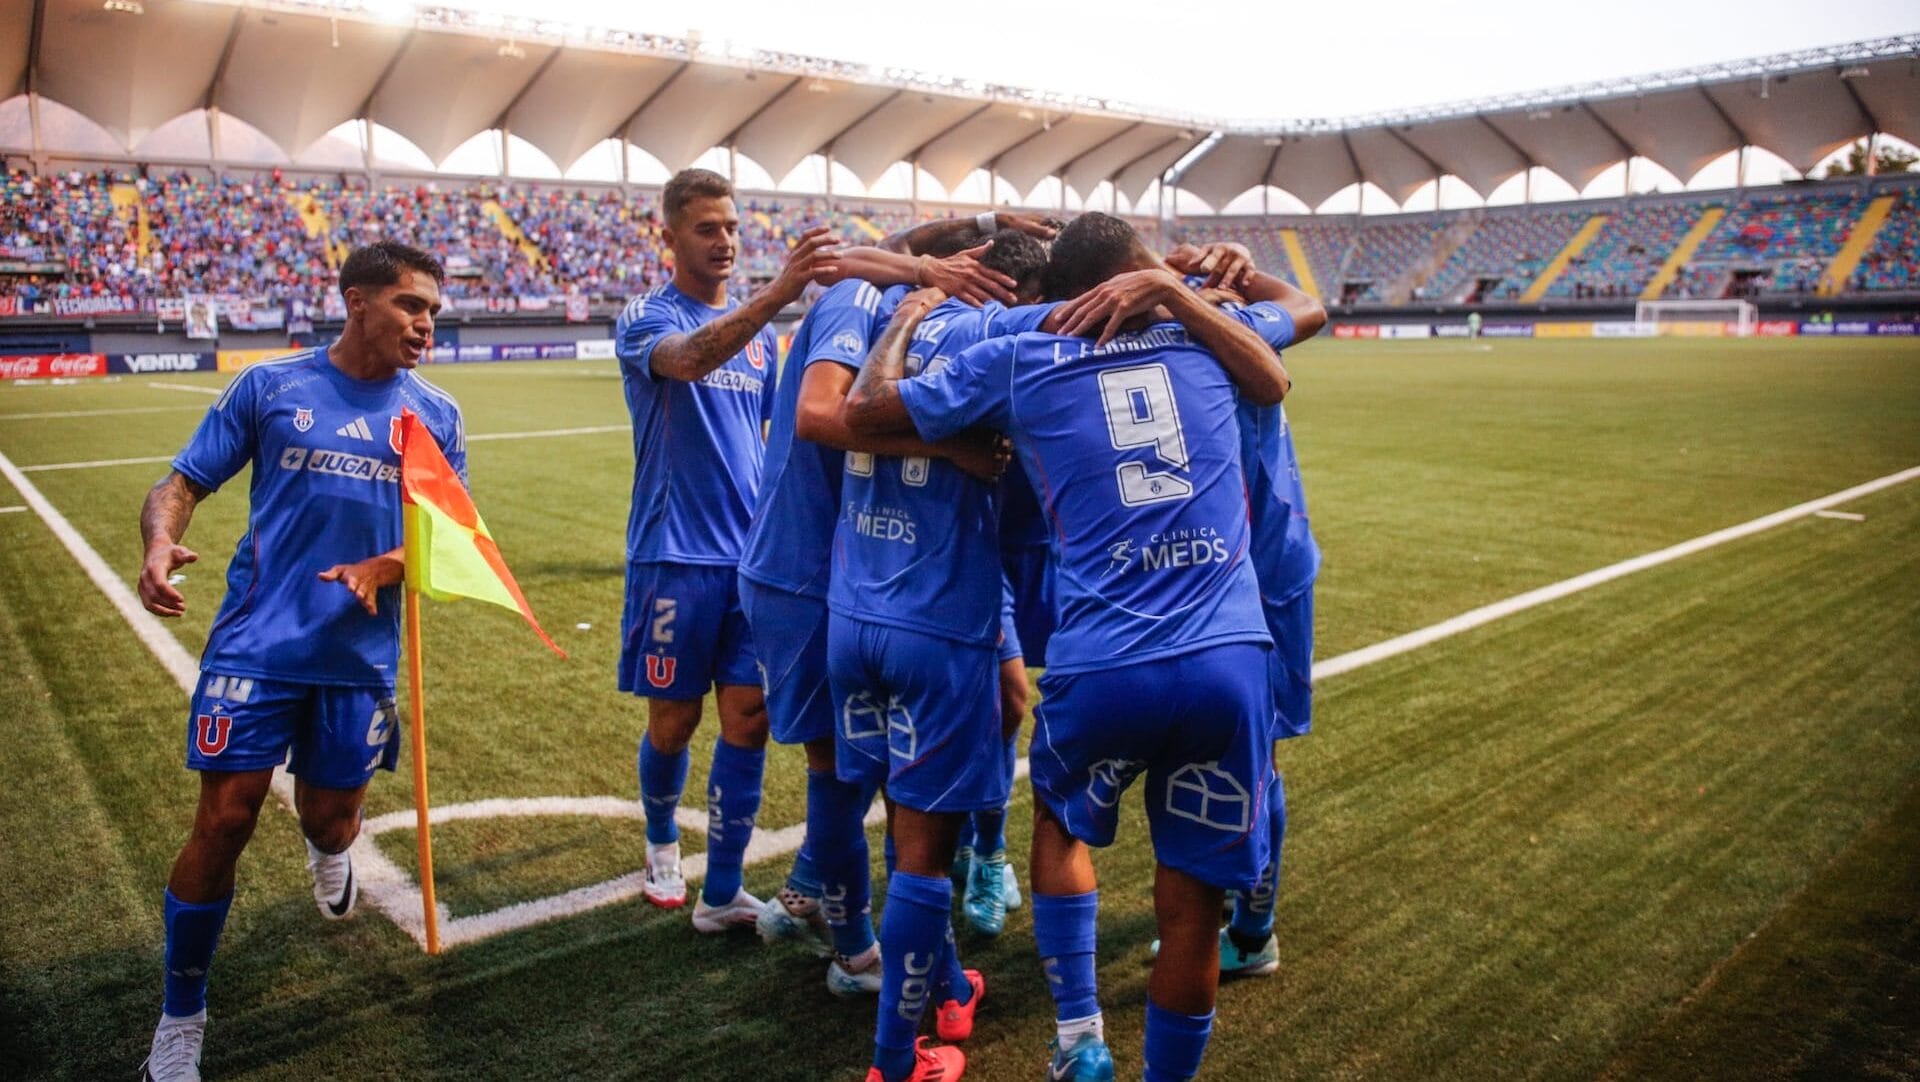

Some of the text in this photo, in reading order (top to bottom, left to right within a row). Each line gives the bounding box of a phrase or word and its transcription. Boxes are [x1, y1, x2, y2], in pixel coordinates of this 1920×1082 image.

[123, 353, 197, 373] VENTUS
[1097, 361, 1194, 508] 9
[856, 512, 916, 544] MEDS
[1150, 526, 1217, 544] CLINICA
[1141, 538, 1229, 572] MEDS
[652, 597, 677, 643] 2
[646, 654, 677, 689] U
[196, 713, 232, 756] U
